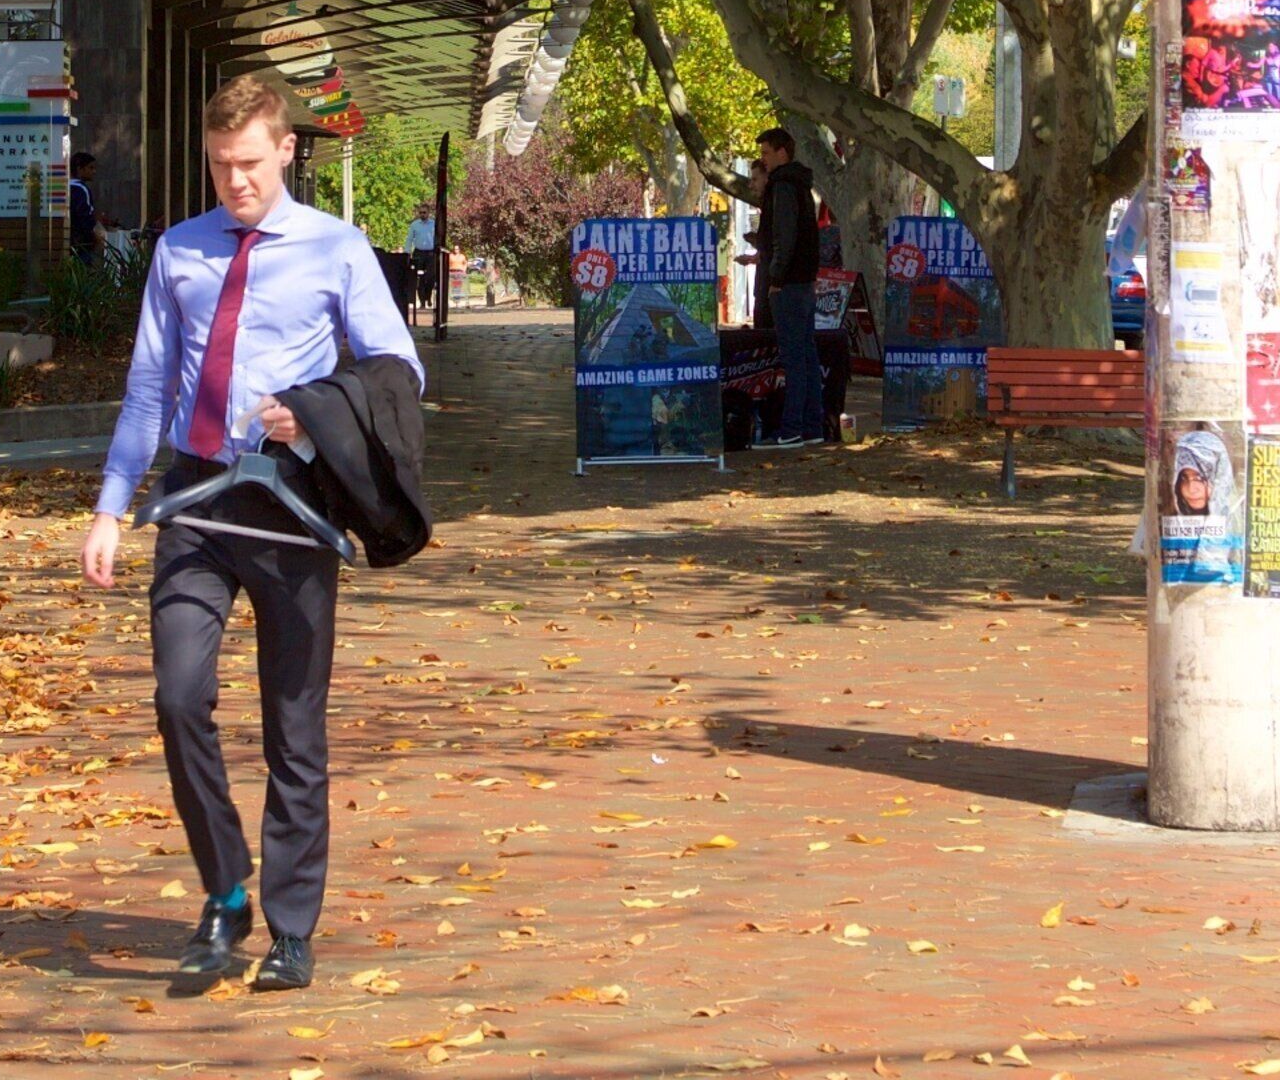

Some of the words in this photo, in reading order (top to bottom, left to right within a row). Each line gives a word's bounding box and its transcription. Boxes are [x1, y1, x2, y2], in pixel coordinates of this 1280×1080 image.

[308, 91, 342, 108] SUBWAY
[573, 222, 715, 254] PAINTBALL
[887, 220, 983, 251] PAINTB
[586, 253, 608, 265] ONLY
[618, 254, 648, 271] PER
[655, 253, 715, 271] PLAYER
[888, 254, 919, 278] $8
[927, 250, 955, 266] PER
[961, 251, 987, 267] PLA
[575, 261, 608, 287] $8
[885, 352, 938, 365] AMAZING
[941, 352, 973, 365] GAME
[576, 370, 634, 386] AMAZING
[637, 368, 674, 383] GAME
[677, 365, 717, 380] ZONES
